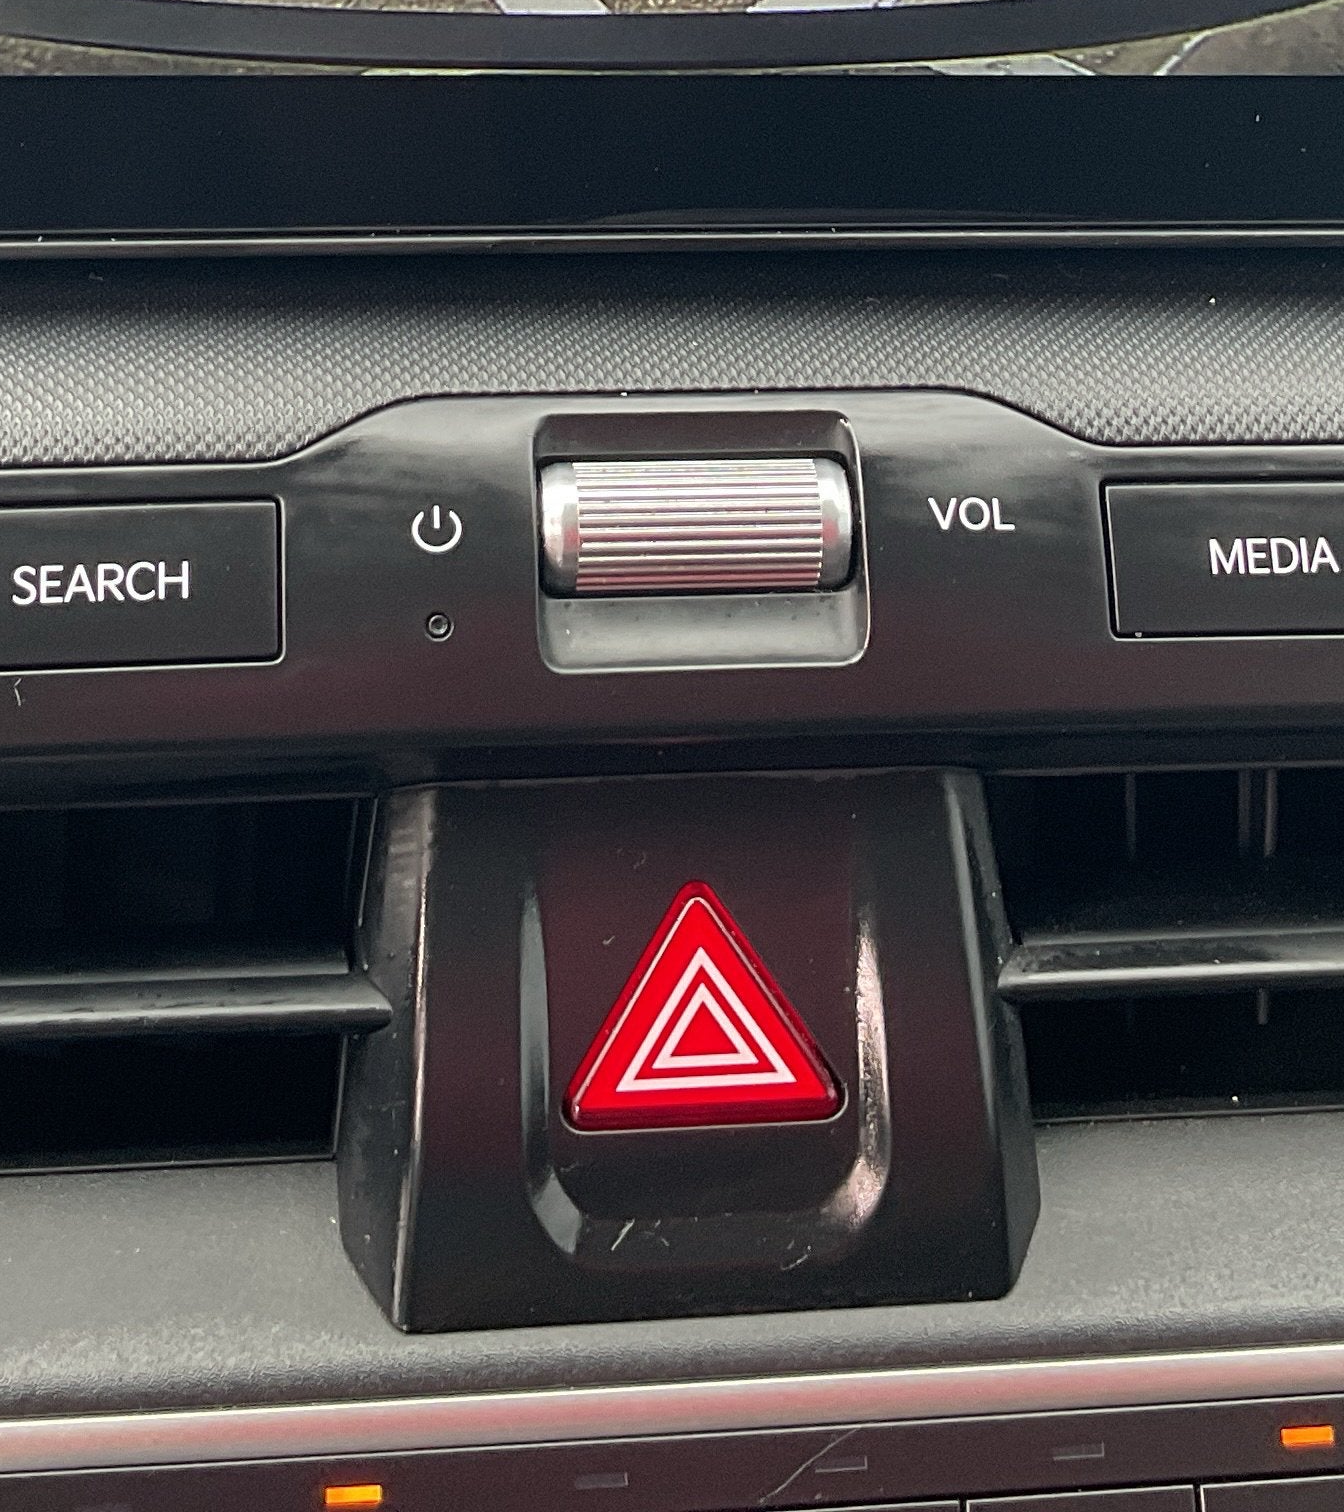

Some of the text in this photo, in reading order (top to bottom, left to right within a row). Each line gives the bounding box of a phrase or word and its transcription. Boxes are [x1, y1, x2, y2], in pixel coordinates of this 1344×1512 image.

[927, 496, 1016, 531] VOL
[1208, 536, 1340, 575] MEDIA
[12, 560, 189, 606] SEARCH
